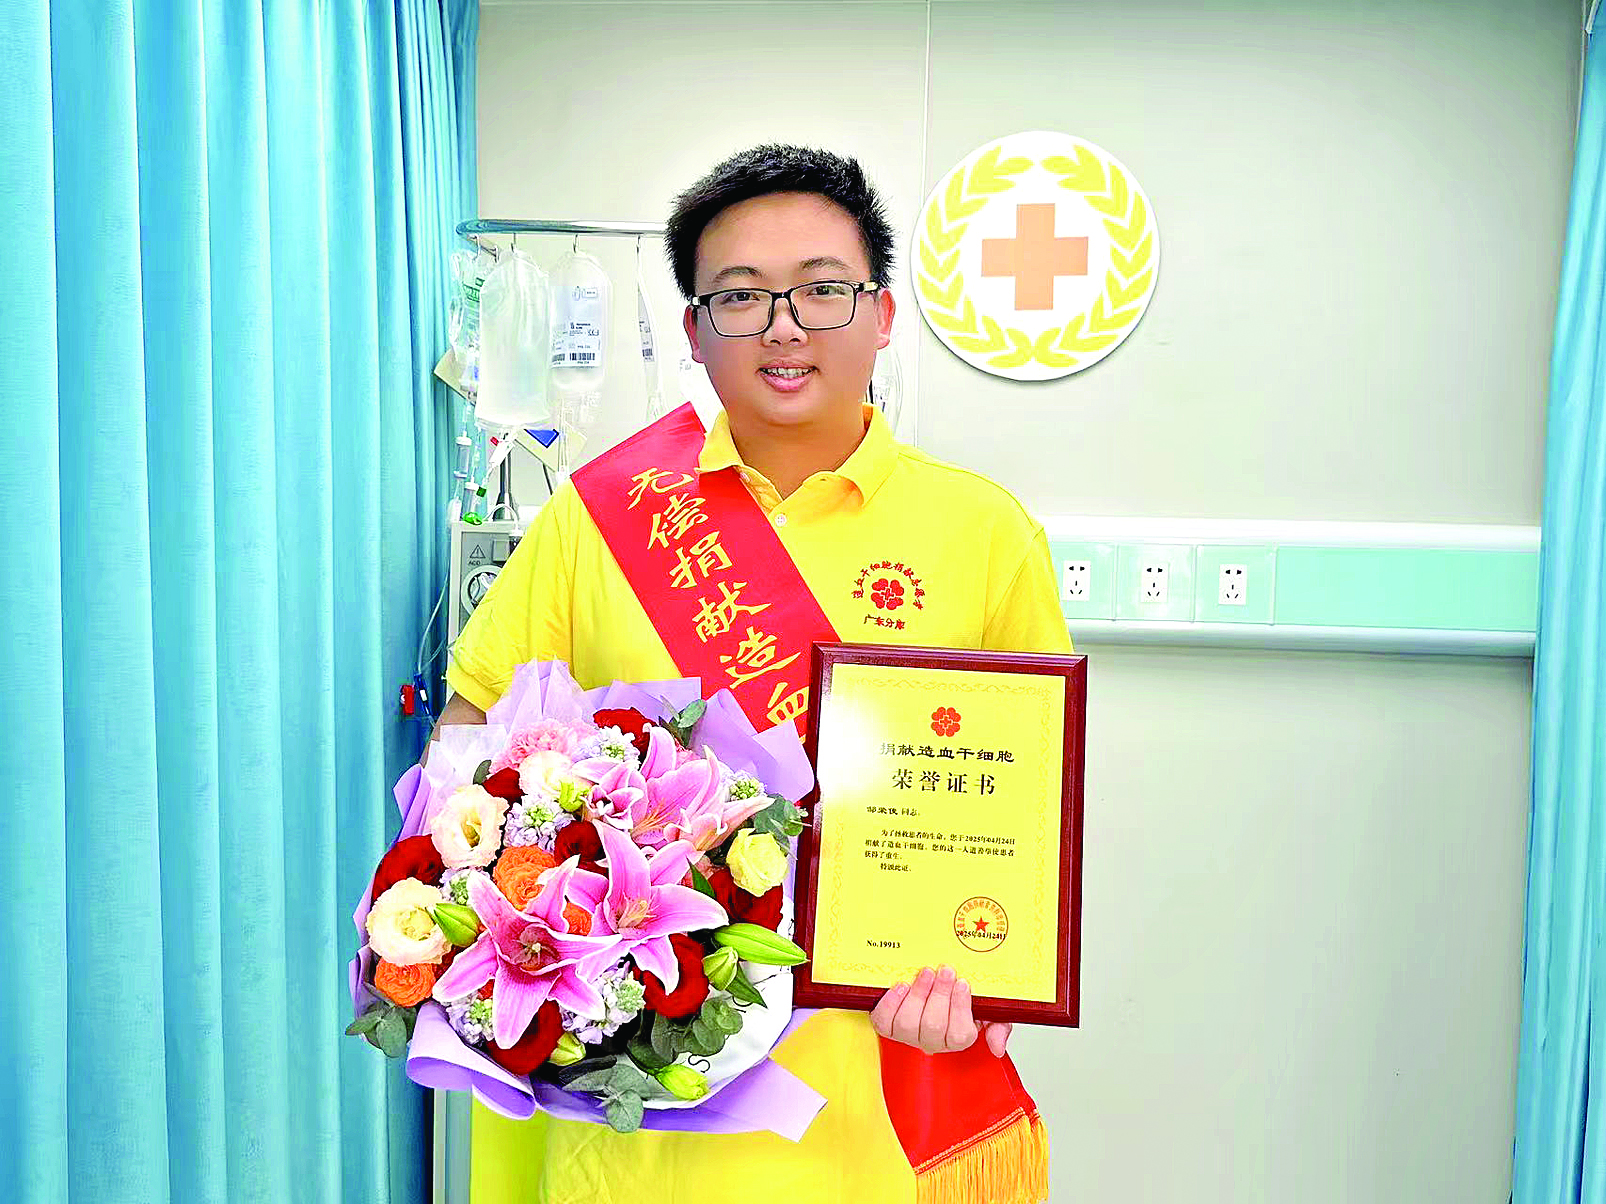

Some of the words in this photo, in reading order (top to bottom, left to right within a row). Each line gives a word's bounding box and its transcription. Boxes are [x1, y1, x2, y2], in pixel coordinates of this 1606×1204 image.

[863, 614, 906, 630] 广东分库
[880, 742, 1015, 763] 捐献造血干细胞
[892, 768, 995, 795] 荣誉证书
